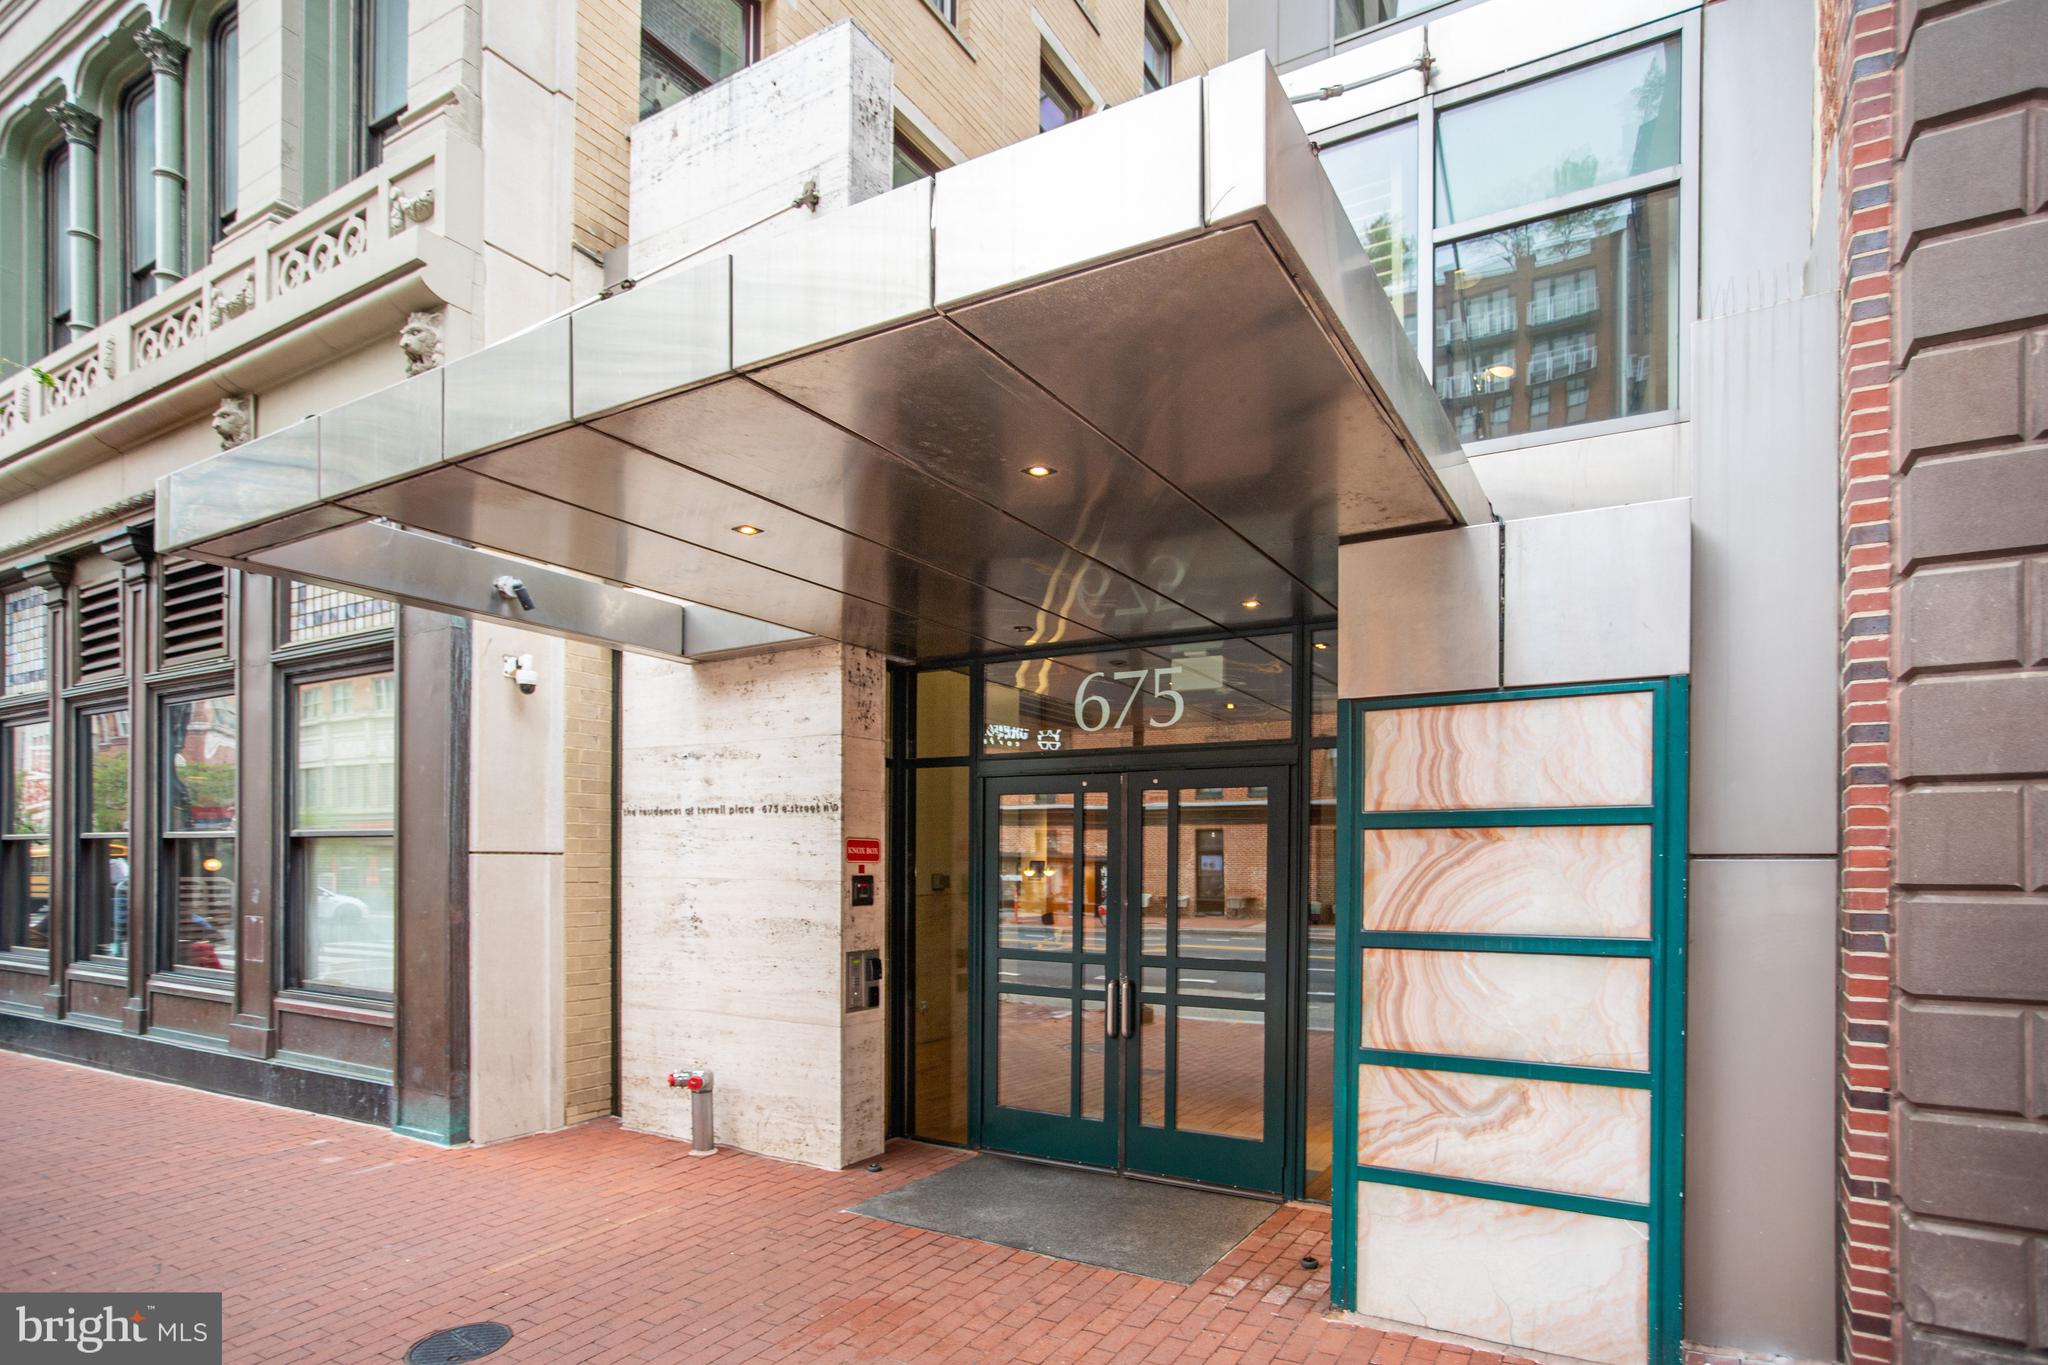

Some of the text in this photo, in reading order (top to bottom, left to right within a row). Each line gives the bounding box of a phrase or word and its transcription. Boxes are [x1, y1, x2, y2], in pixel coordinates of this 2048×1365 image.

[1075, 666, 1186, 733] 675
[624, 806, 636, 816] the
[639, 805, 682, 816] residences
[685, 806, 694, 816] at
[697, 804, 726, 815] terrell
[729, 804, 755, 815] place
[762, 804, 779, 814] 675
[848, 847, 879, 855] KNOX BOX
